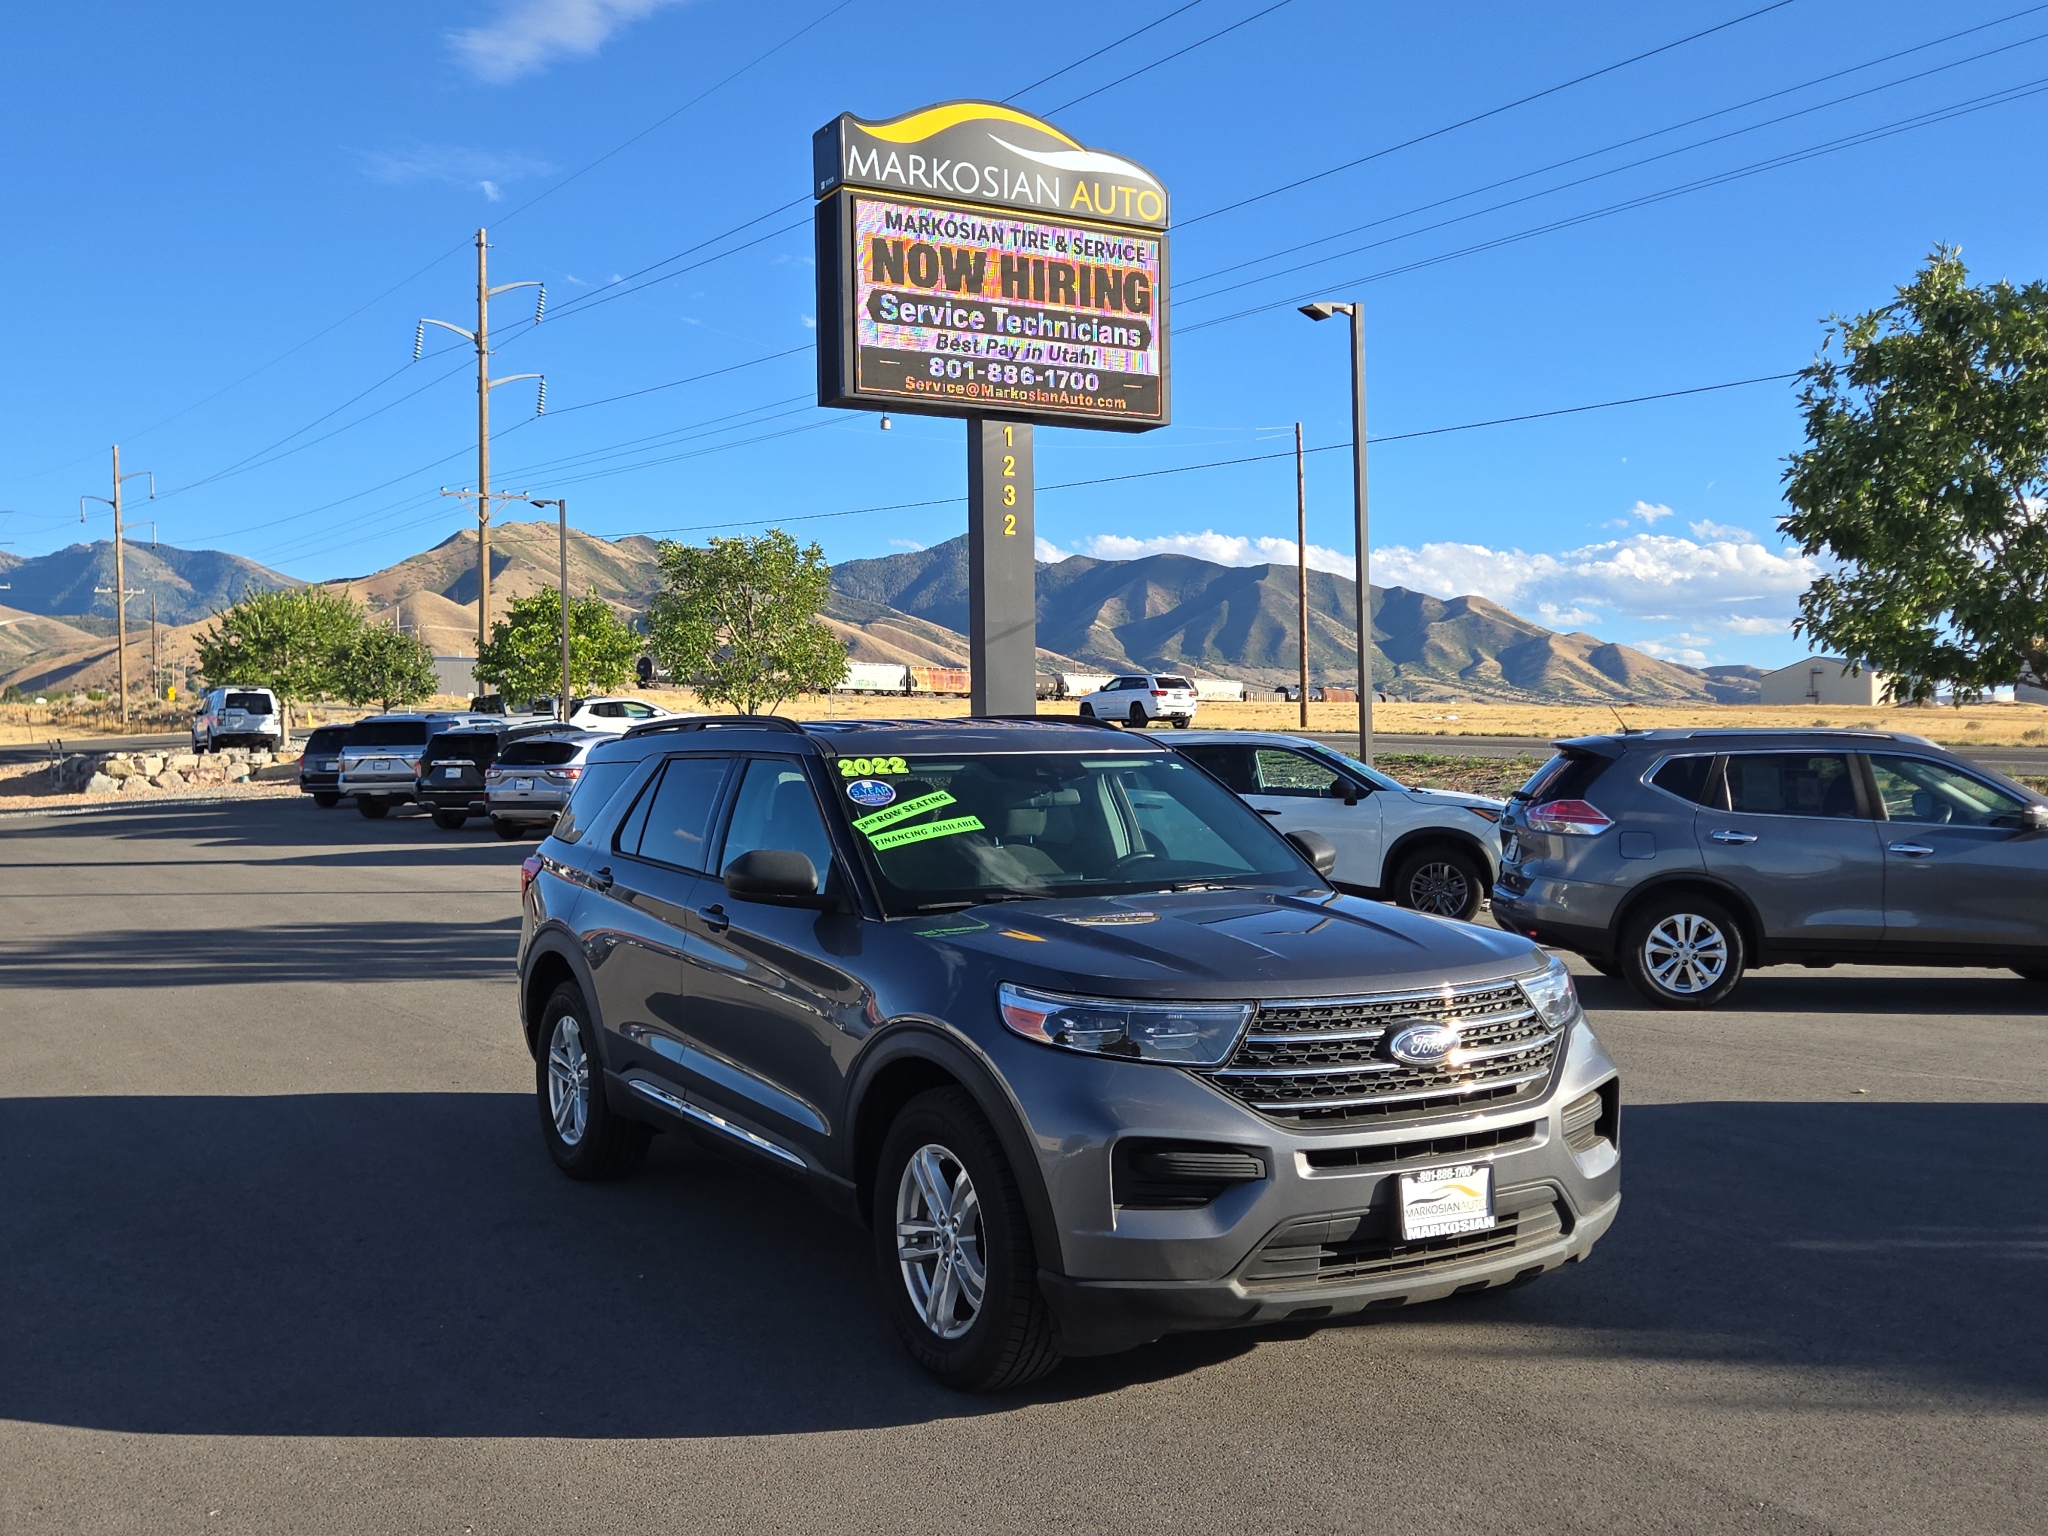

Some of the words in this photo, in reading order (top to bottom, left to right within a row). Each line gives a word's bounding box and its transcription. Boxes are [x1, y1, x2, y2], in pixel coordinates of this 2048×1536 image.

[848, 145, 1060, 207] MARKOSIAN
[1070, 180, 1162, 221] AUTO
[884, 210, 1003, 244] MARKOSIAN
[1010, 227, 1049, 251] TIRE
[1055, 235, 1069, 253] &
[1073, 237, 1146, 263] SERVICE
[872, 238, 987, 294] NOW
[1001, 254, 1151, 315] HIRING
[879, 292, 986, 331] Service
[992, 306, 1141, 347] Technicians
[935, 332, 980, 355] Best
[986, 337, 1018, 361] Pay
[1025, 344, 1043, 362] in
[1050, 345, 1098, 366] Utah!
[929, 357, 1099, 391] 801-886-1700
[905, 375, 1127, 410] Service@MarkosianAuto.com
[837, 756, 910, 777] 2022
[851, 788, 860, 796] 5
[860, 786, 890, 796] YEAR
[877, 808, 903, 823] ROW
[902, 793, 949, 813] SEATING
[875, 828, 928, 847] FINANCING
[932, 819, 980, 834] AVAILABLE
[1406, 1216, 1496, 1241] MARKOSIAN
